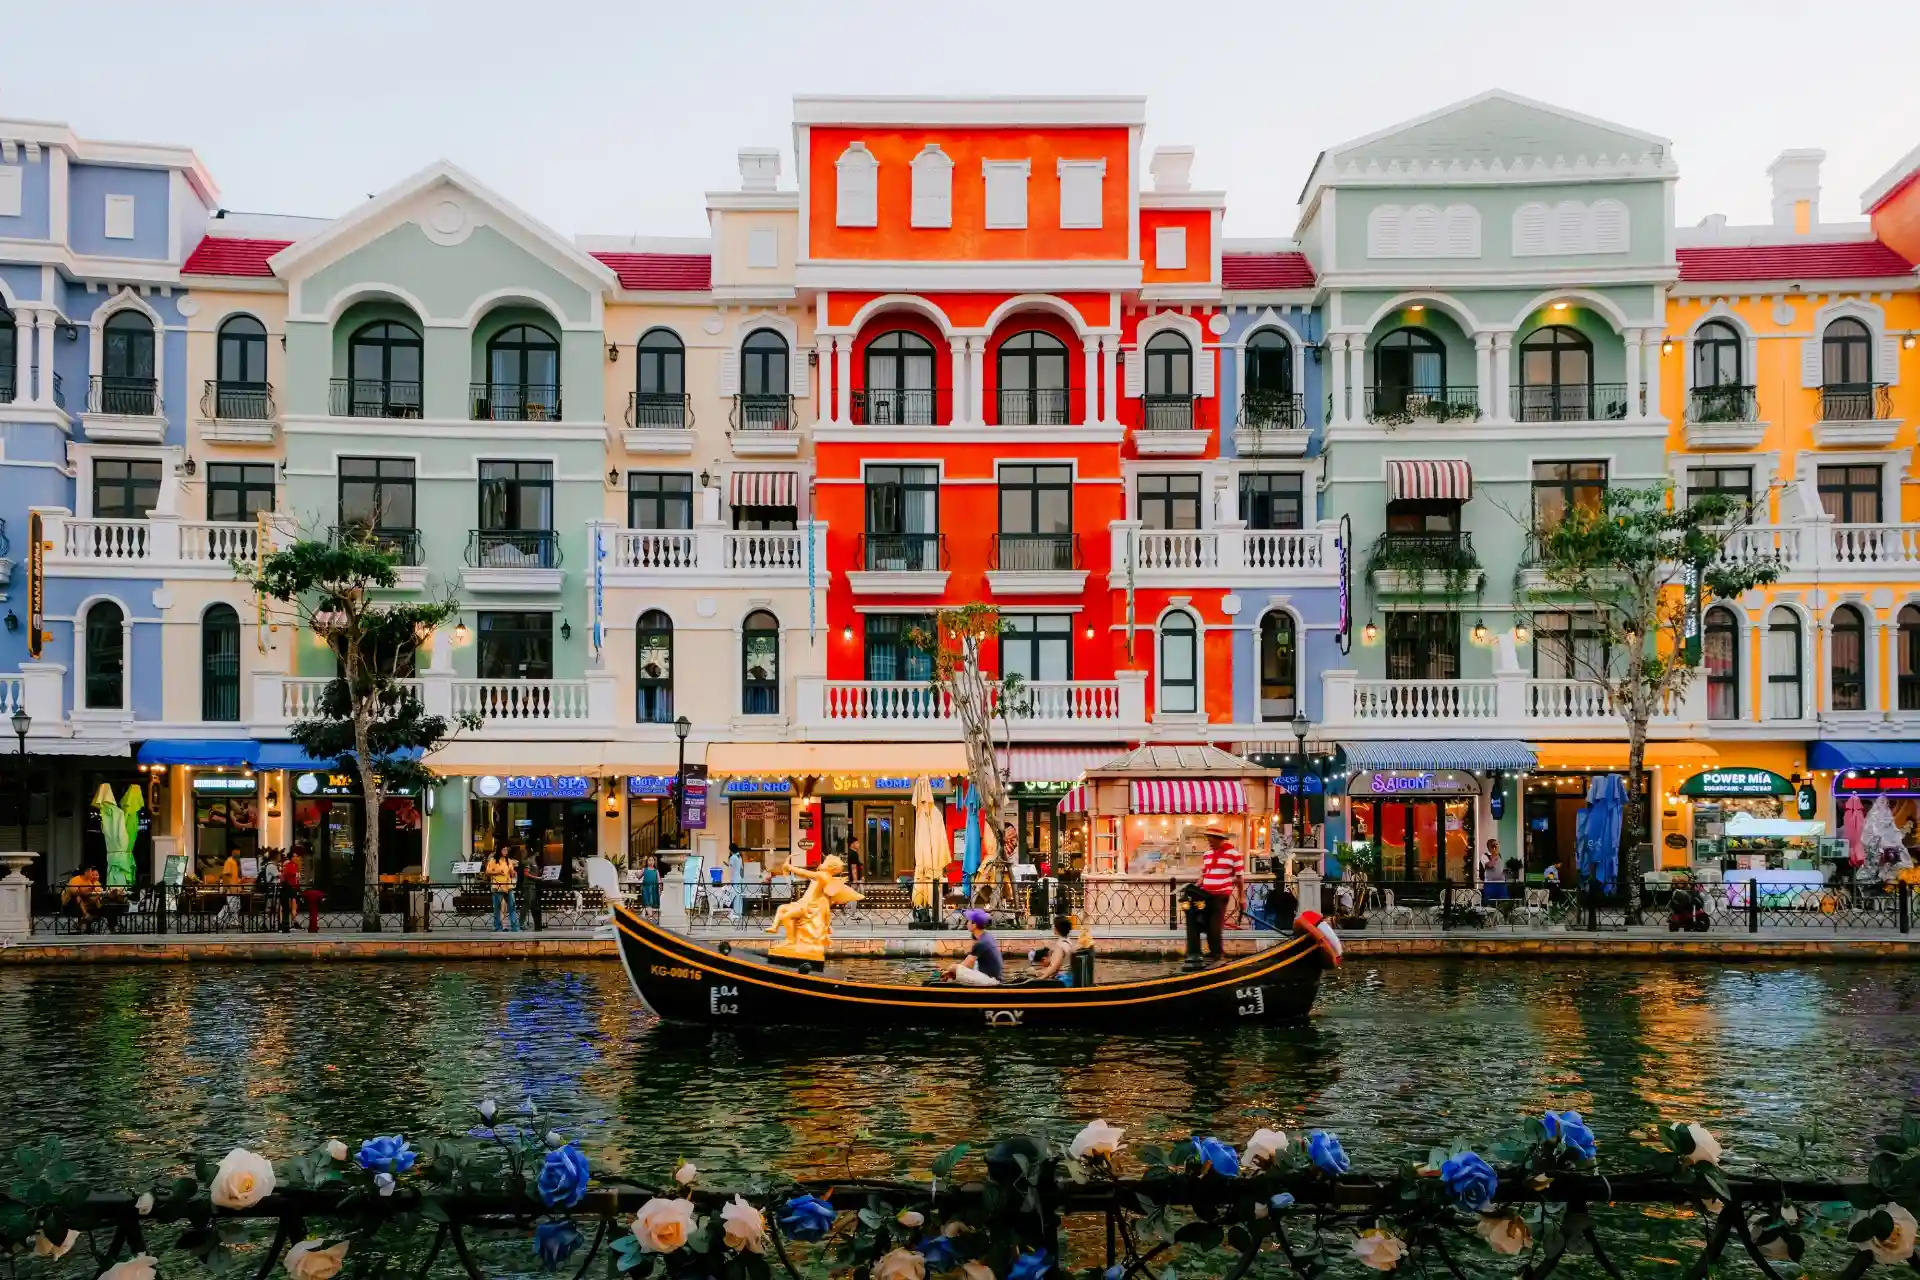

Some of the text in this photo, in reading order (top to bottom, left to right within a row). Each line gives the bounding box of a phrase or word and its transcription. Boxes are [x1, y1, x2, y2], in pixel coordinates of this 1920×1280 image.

[506, 777, 588, 789] LOCAL SPA
[631, 777, 653, 786] FOOT
[833, 777, 858, 790] Spa
[875, 778, 911, 789] HOME
[1371, 773, 1435, 793] SAIGON
[1703, 771, 1772, 784] POWER MÍA
[720, 985, 739, 997] 0.4
[720, 1003, 739, 1014] 0.2
